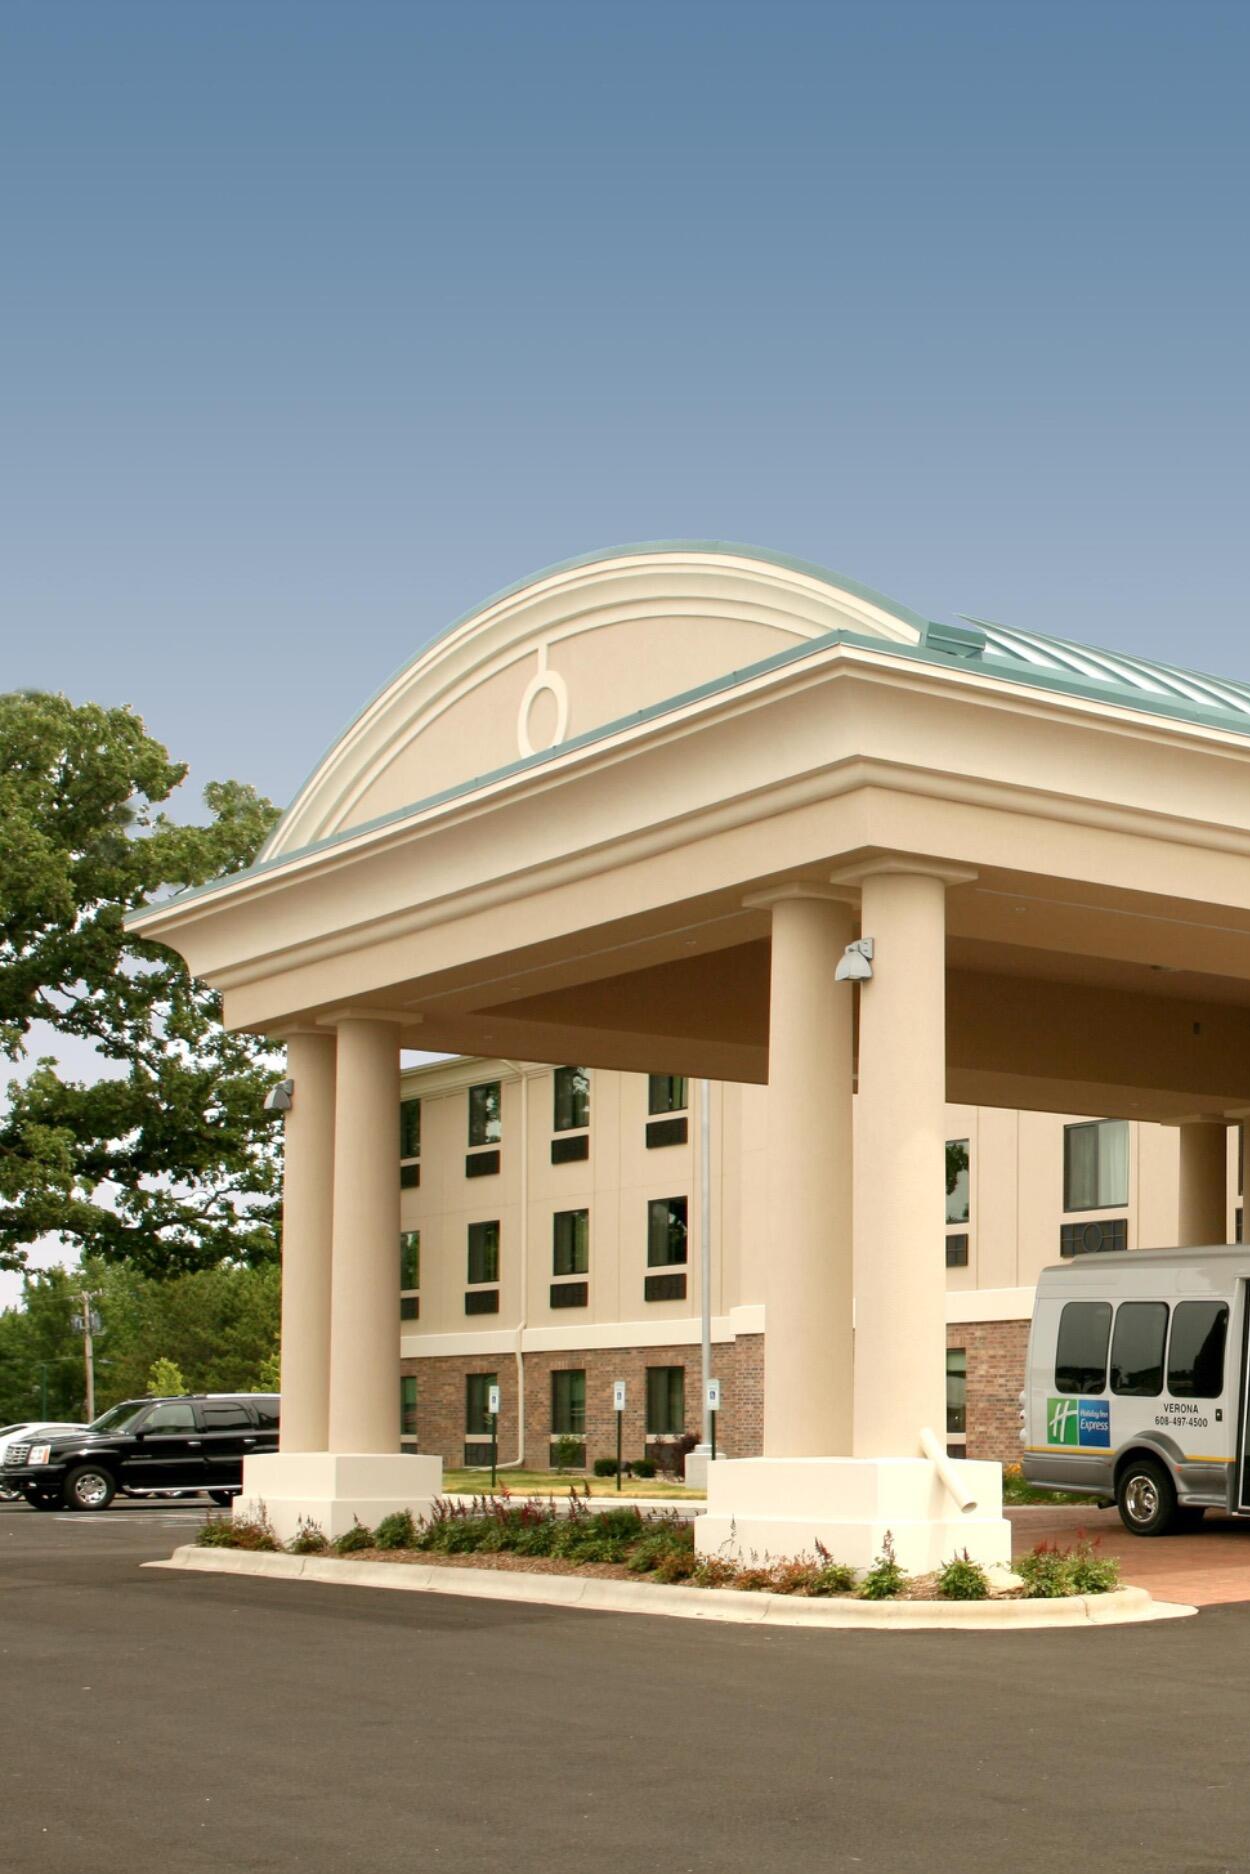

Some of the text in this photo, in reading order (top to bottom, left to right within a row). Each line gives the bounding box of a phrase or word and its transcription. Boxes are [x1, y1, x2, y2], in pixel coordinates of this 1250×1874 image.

[1163, 1403, 1199, 1414] VERONA
[1080, 1418, 1109, 1432] Express
[1155, 1415, 1208, 1428] 608-497-4500
